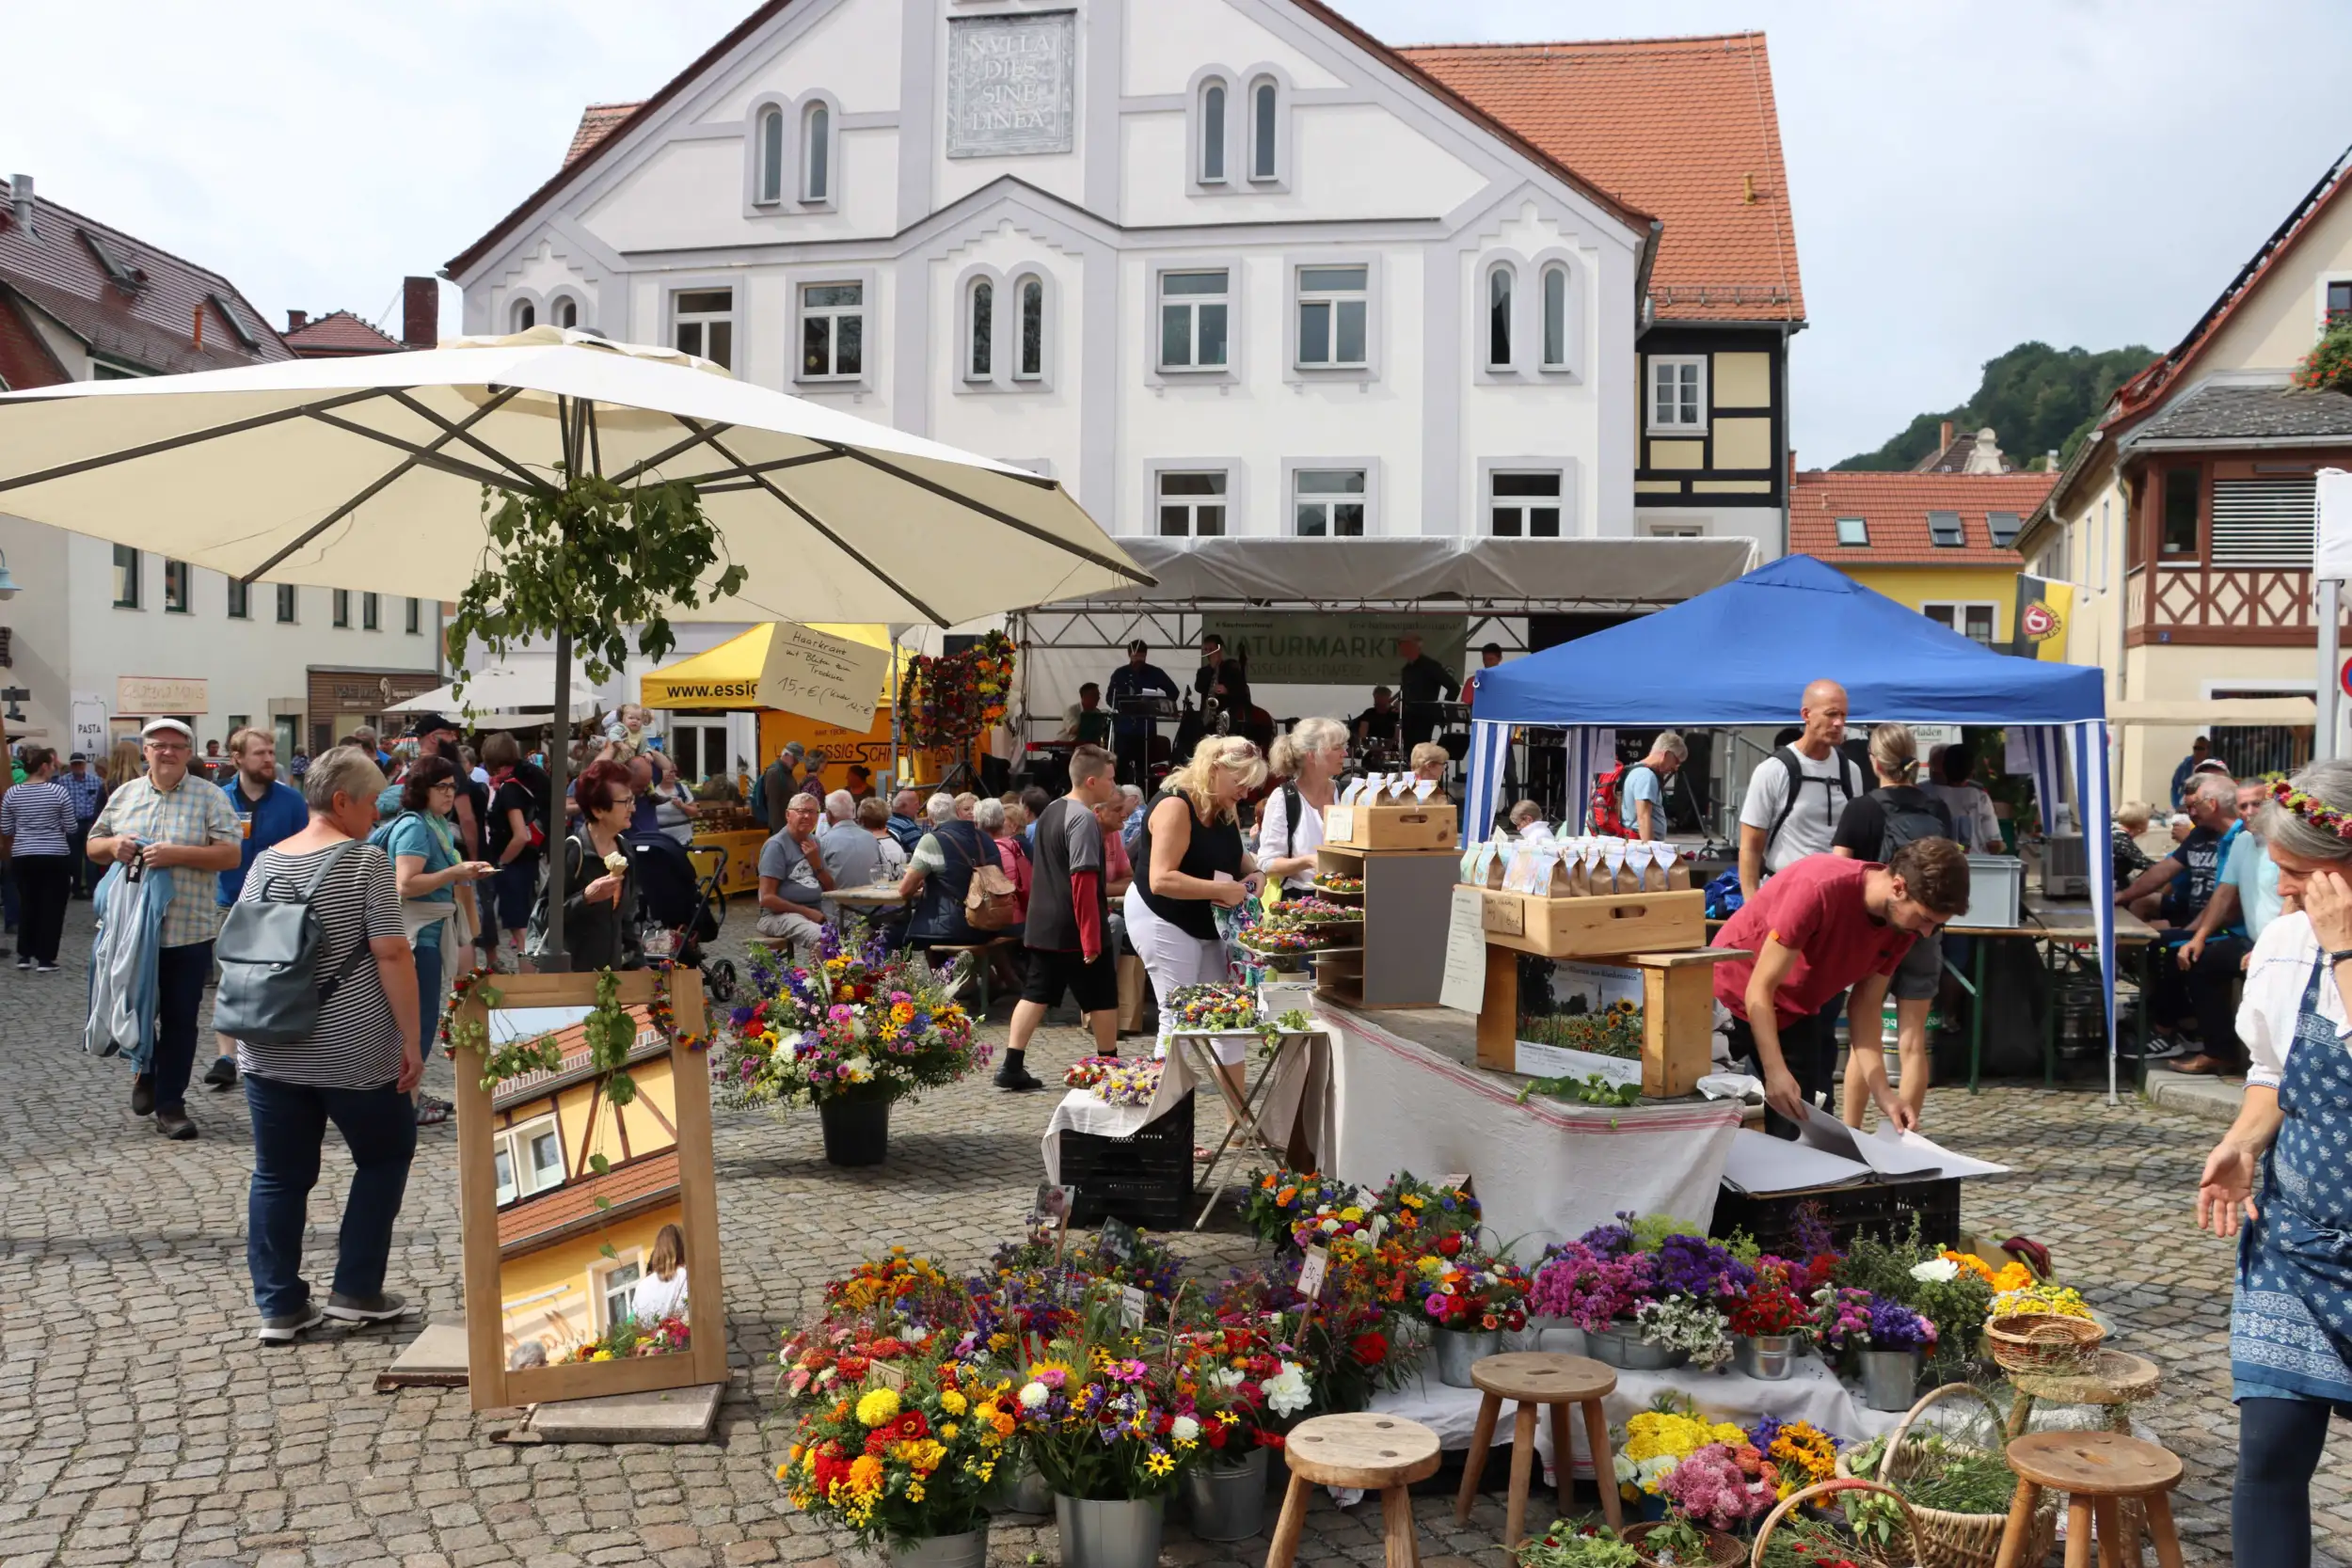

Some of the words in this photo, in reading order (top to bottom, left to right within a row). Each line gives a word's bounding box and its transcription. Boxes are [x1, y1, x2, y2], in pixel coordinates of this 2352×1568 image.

[984, 59, 1037, 79] DIES
[982, 83, 1038, 103] SINE
[972, 110, 1044, 130] LINEA
[1223, 635, 1400, 658] NATURMARKT
[78, 723, 101, 734] PASTA
[87, 738, 93, 749] &
